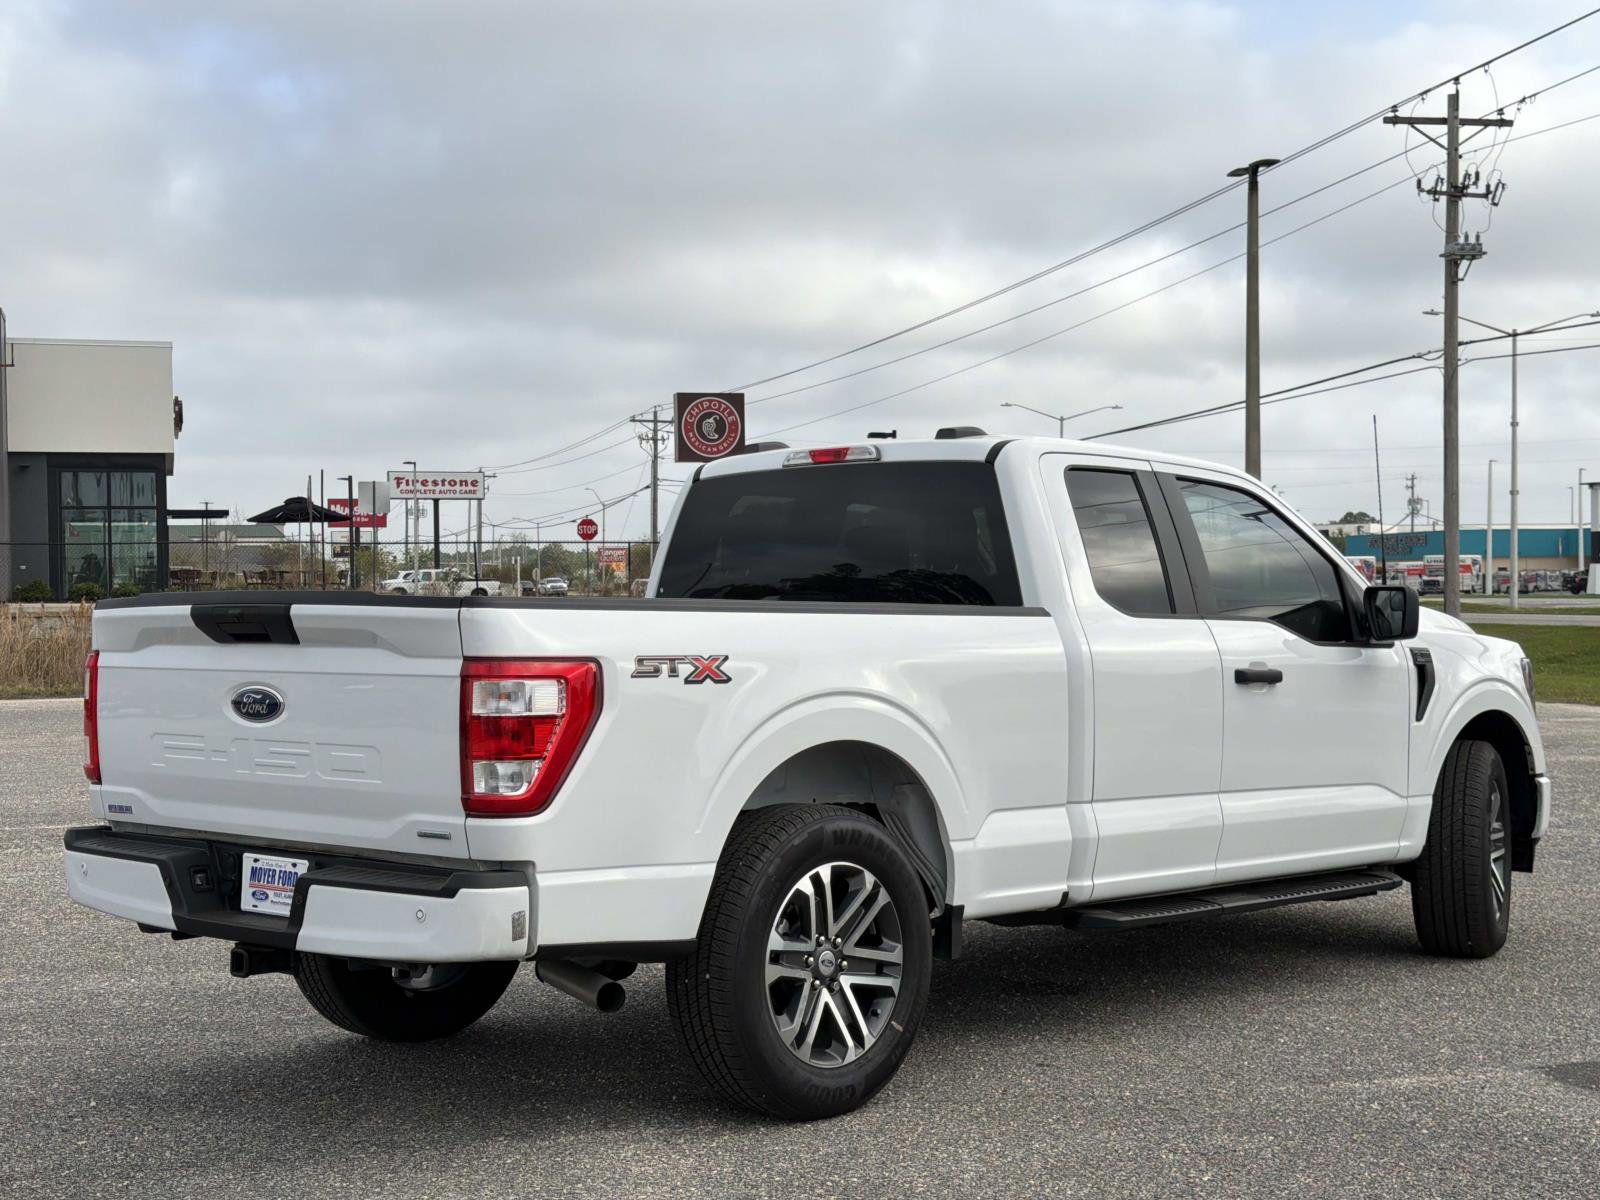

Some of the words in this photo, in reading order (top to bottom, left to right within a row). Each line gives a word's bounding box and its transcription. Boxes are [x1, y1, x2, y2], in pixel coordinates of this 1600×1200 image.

[686, 401, 737, 424] CHIPOTLE
[393, 476, 479, 489] Firestone
[578, 525, 597, 535] STOP
[630, 655, 732, 684] STX
[240, 694, 269, 715] Ford
[151, 732, 383, 784] F-150
[250, 866, 277, 885] MOYER
[277, 869, 299, 887] FORD
